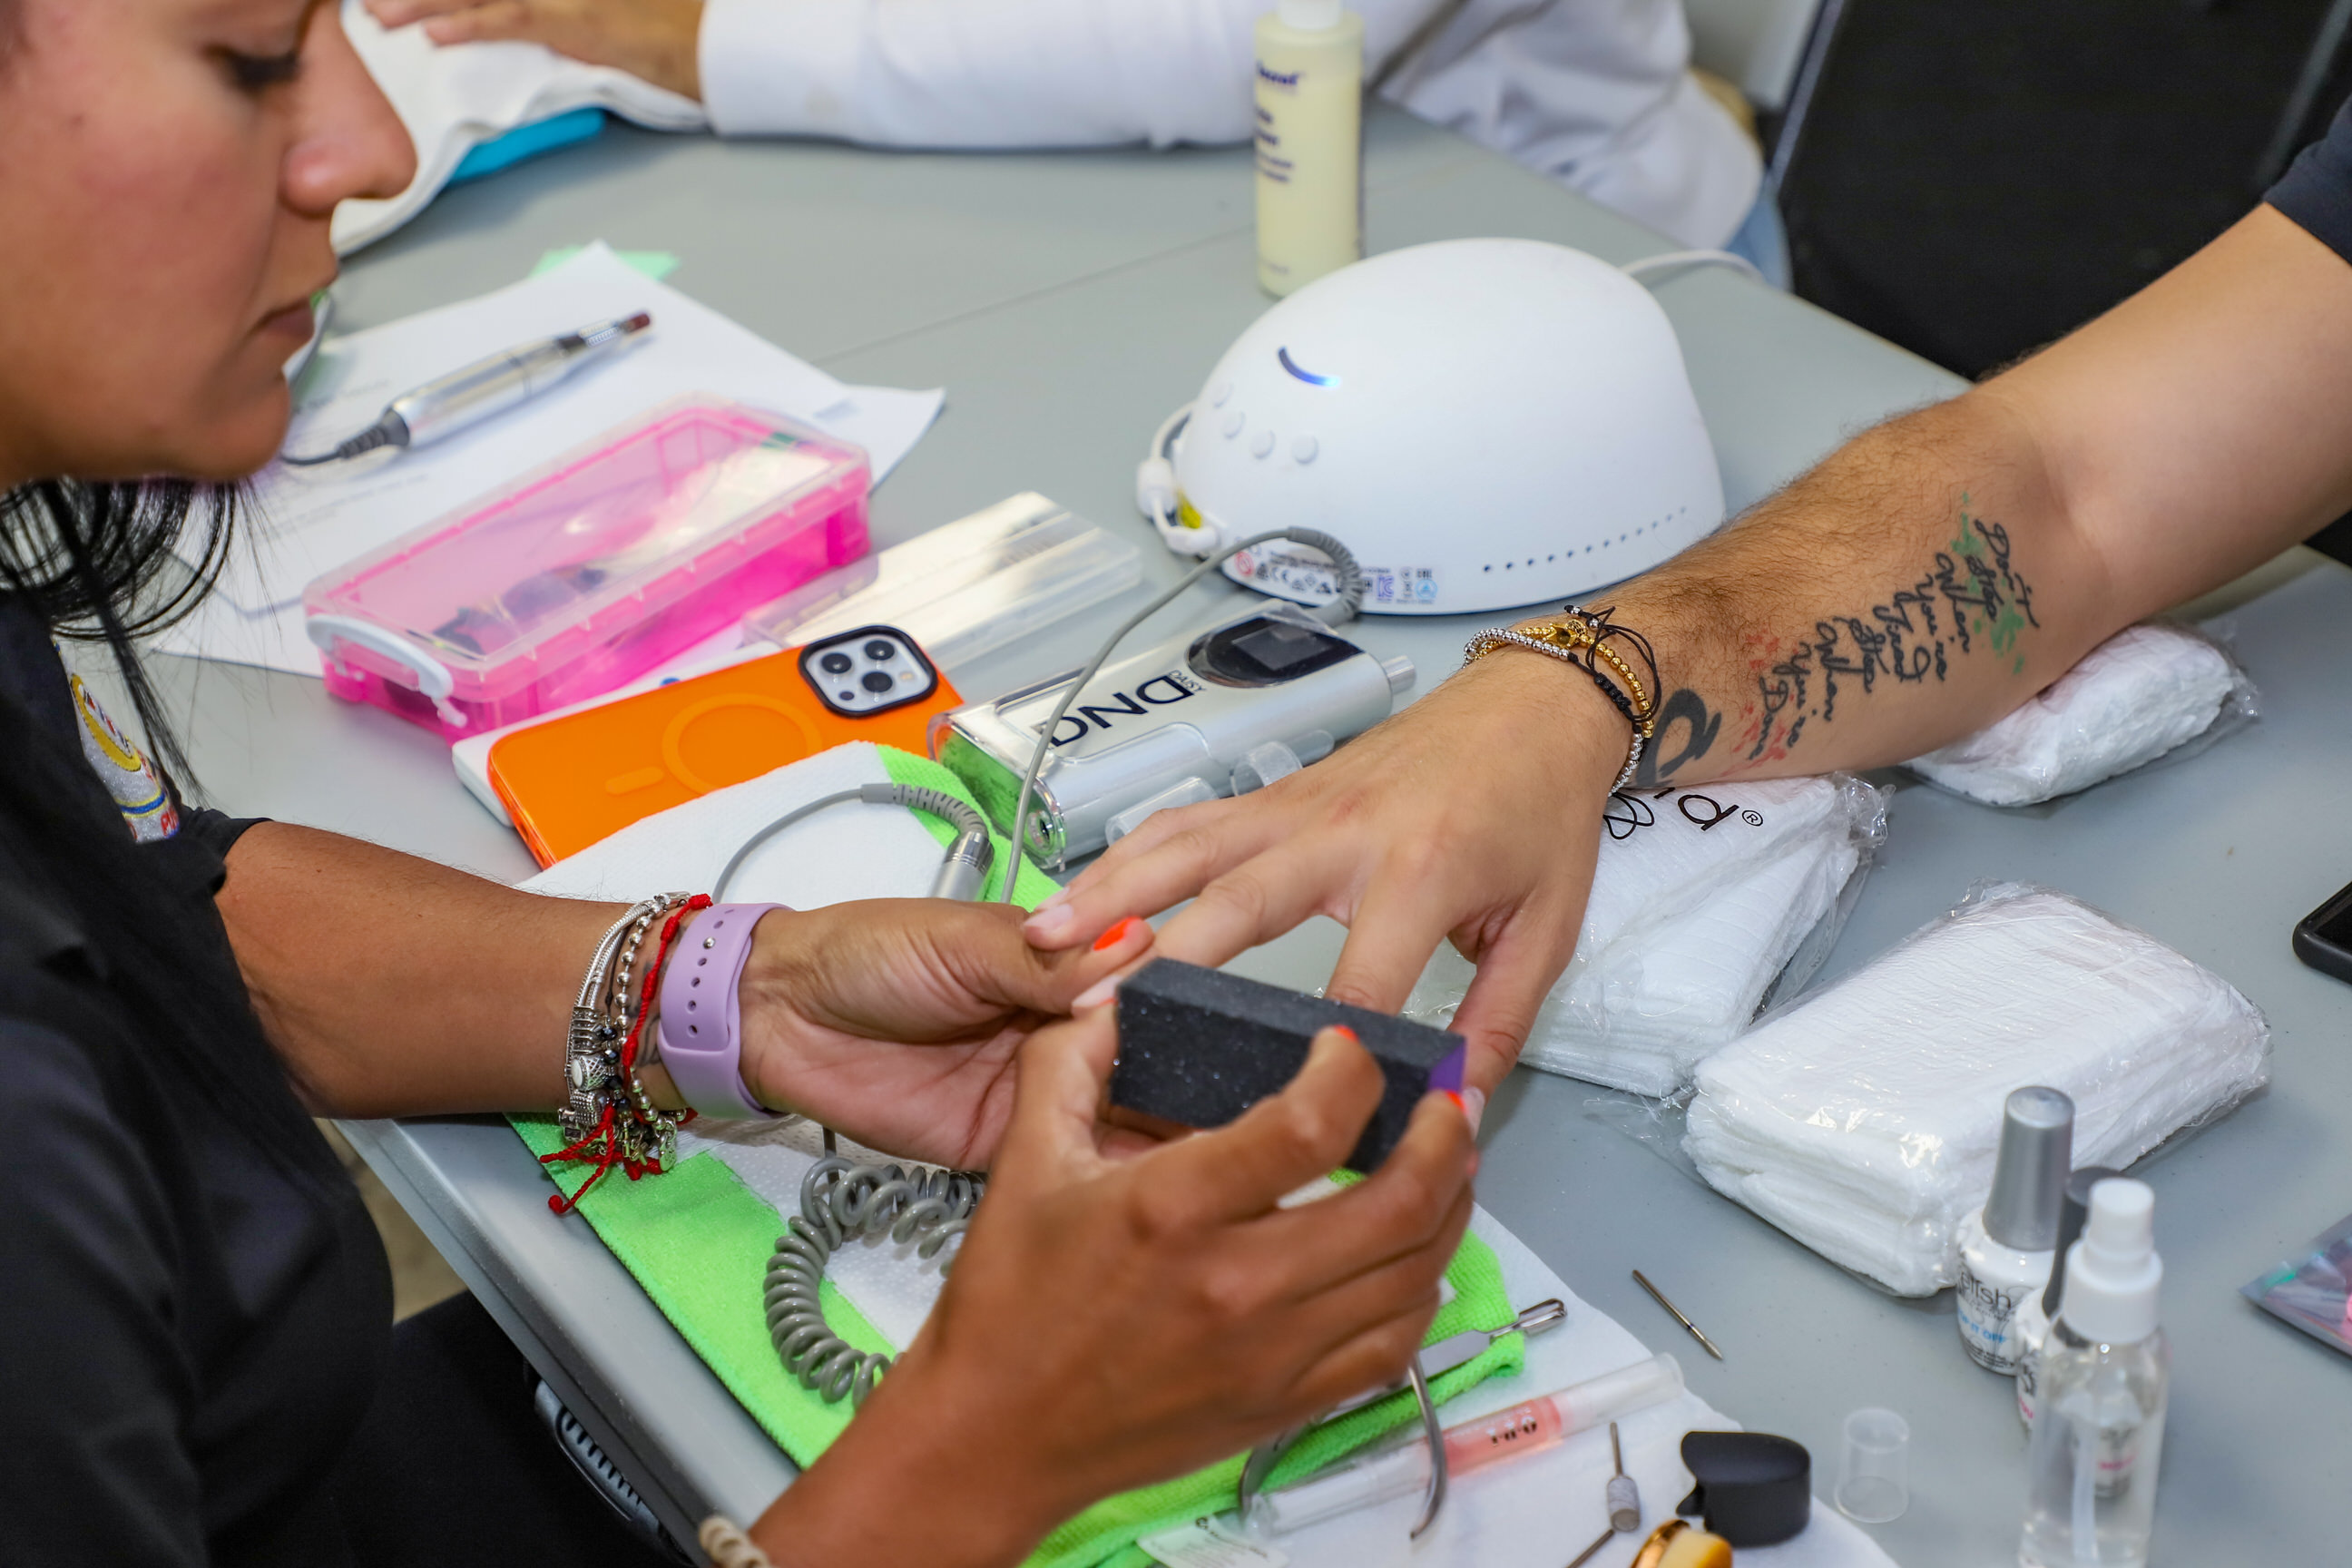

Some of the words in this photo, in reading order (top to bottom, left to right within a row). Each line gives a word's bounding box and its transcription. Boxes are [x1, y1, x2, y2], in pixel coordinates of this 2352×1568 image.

[1934, 552, 1988, 655] When
[1974, 518, 2041, 629] Don't
[1815, 621, 1872, 722] When
[1893, 572, 1956, 682] You're
[1747, 674, 1790, 761] Done
[1771, 641, 1818, 749] You're
